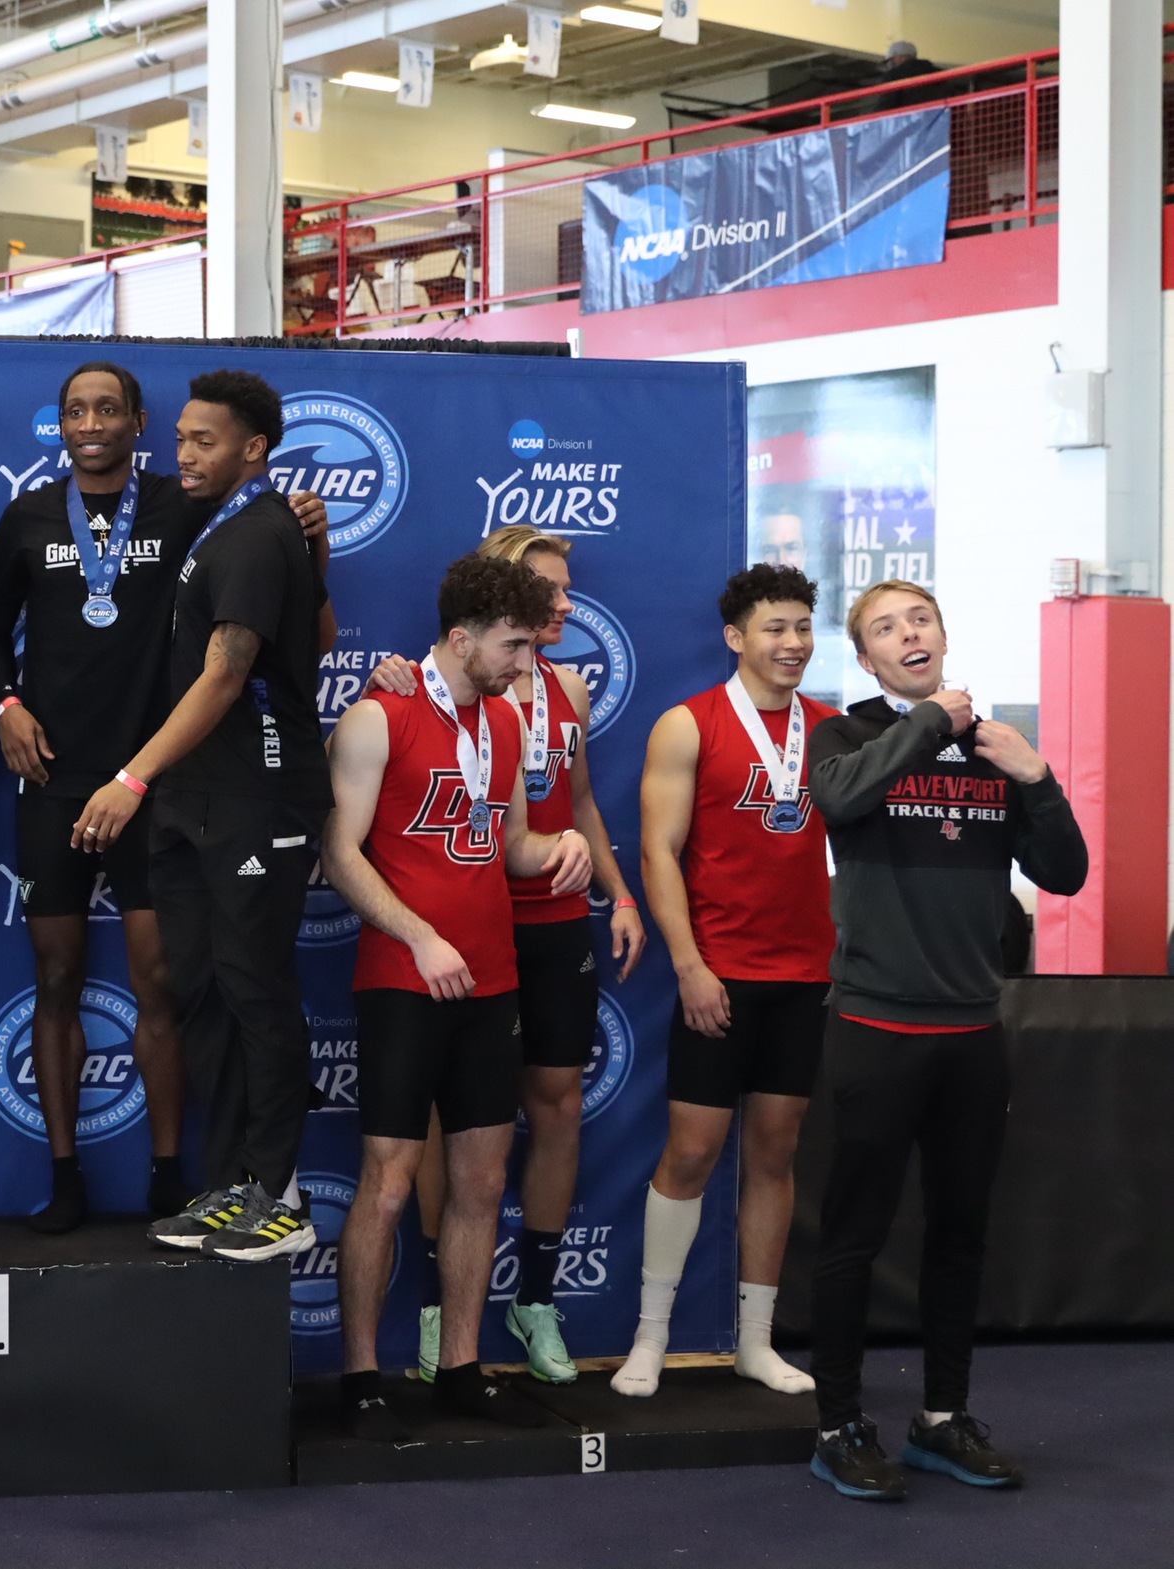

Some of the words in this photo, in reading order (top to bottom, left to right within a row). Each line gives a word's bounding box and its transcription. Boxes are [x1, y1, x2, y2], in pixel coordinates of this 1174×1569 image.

[620, 228, 686, 263] NCAA
[692, 216, 769, 251] Division
[774, 211, 787, 238] II
[36, 424, 61, 436] NCA
[305, 403, 397, 489] INTERCOLLEGIATE
[511, 438, 544, 449] NCAA
[547, 438, 585, 450] Division
[587, 440, 593, 450] II
[269, 467, 377, 497] GLIAC
[530, 462, 596, 482] MAKE
[600, 464, 622, 482] IT
[476, 468, 619, 539] YOURS
[326, 499, 390, 545] NFERENCE
[319, 651, 364, 669] AKE
[262, 714, 276, 727] &
[263, 728, 281, 768] FIELD
[886, 804, 945, 818] TRACK
[948, 807, 962, 819] &
[967, 808, 1006, 821] FIELD
[237, 867, 267, 875] adidas
[305, 914, 362, 935] CONFER
[313, 1016, 352, 1027] Division
[76, 1084, 146, 1132] NFERENCE
[560, 1227, 588, 1245] KE
[591, 1225, 613, 1244] IT
[584, 1436, 603, 1468] 3
